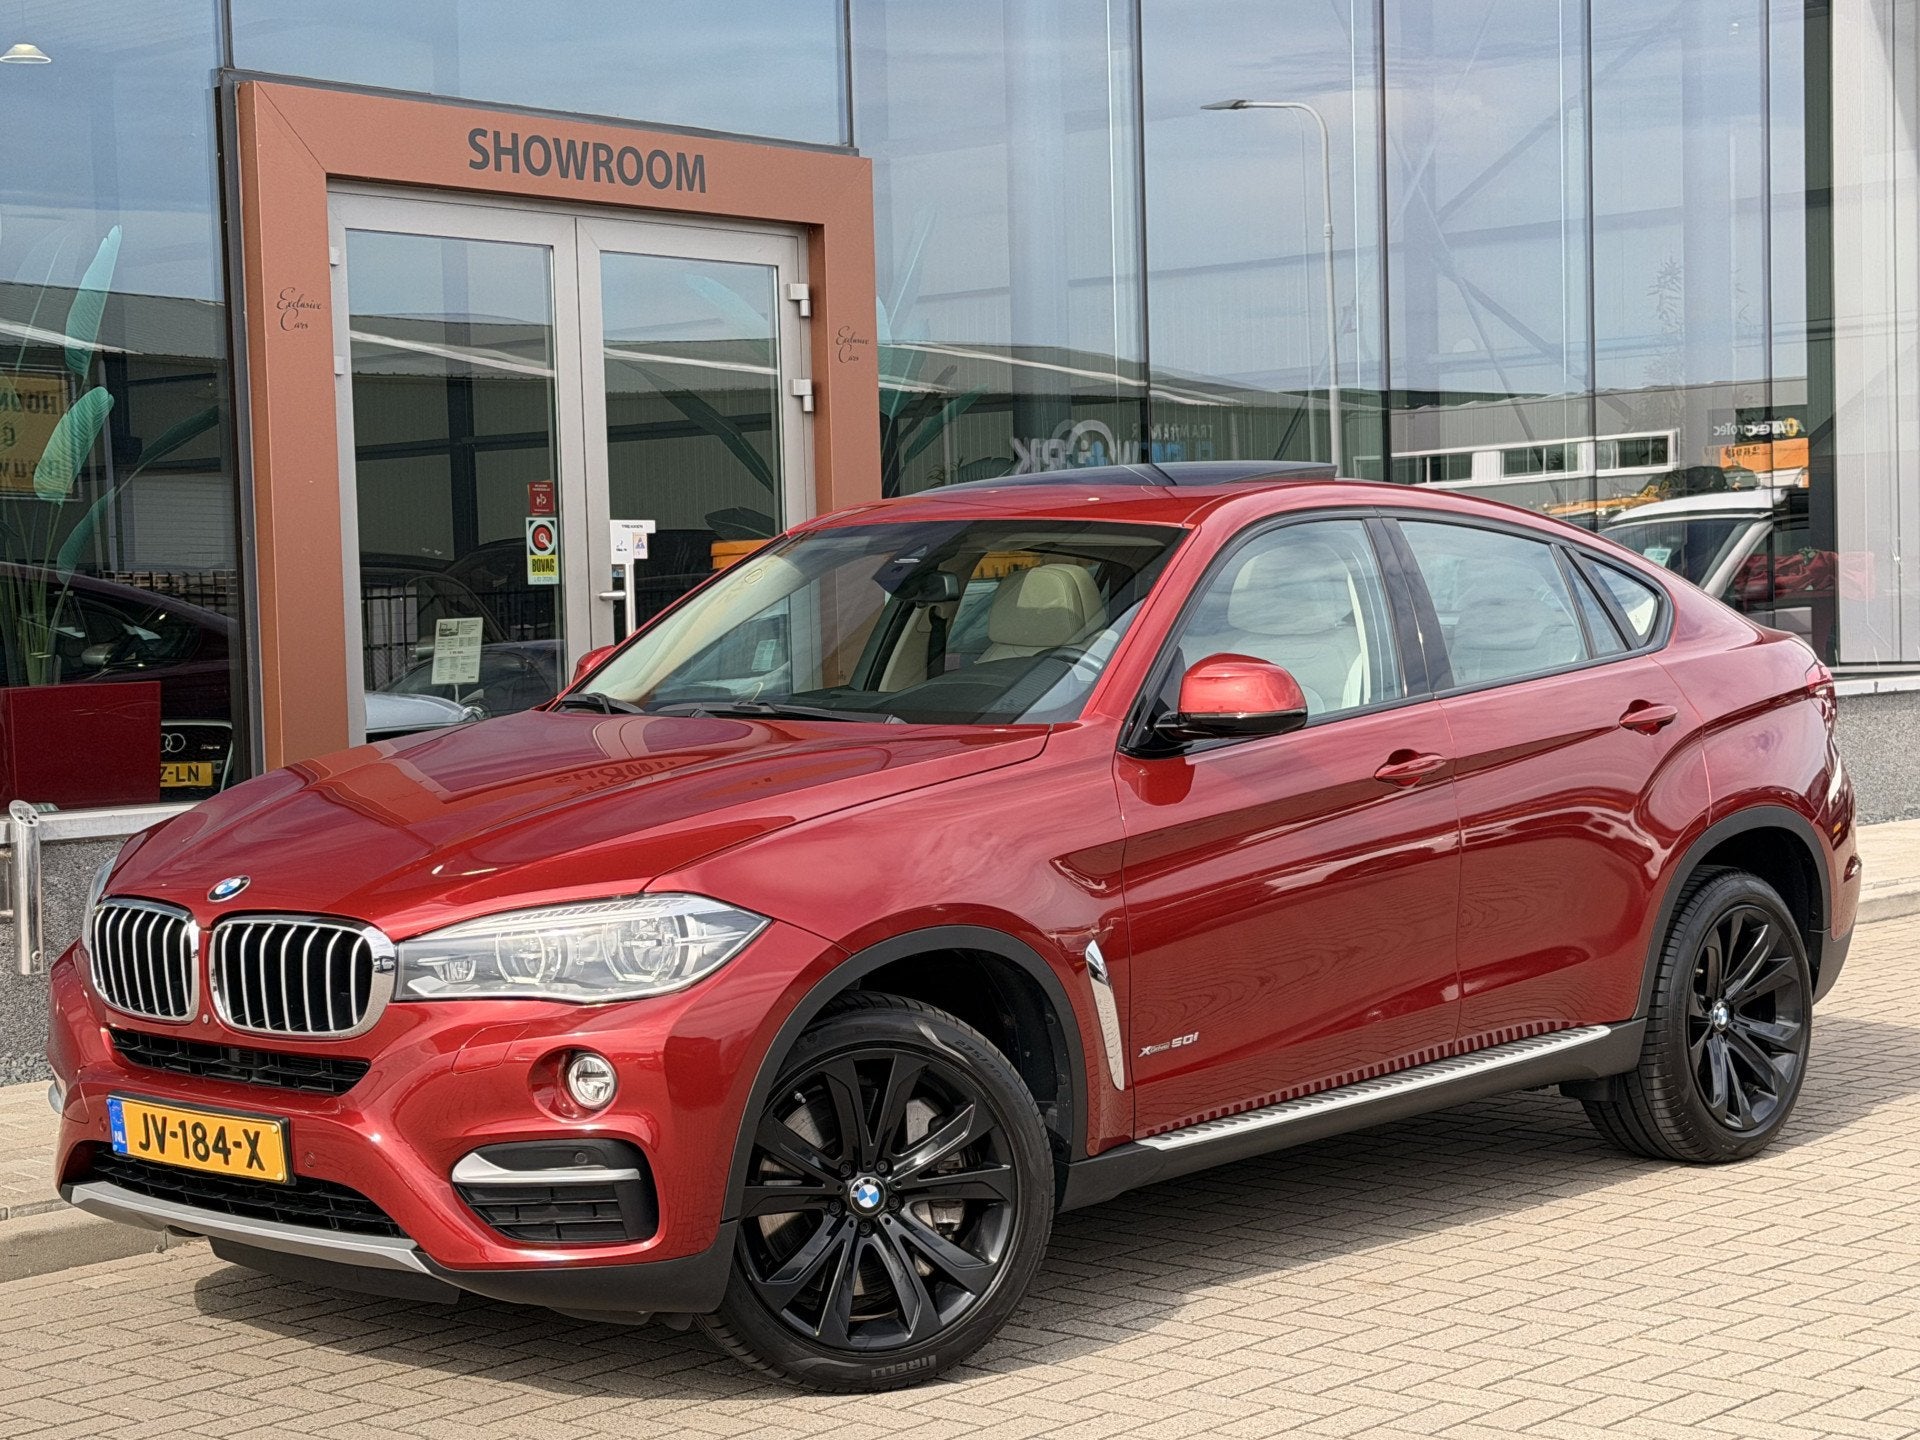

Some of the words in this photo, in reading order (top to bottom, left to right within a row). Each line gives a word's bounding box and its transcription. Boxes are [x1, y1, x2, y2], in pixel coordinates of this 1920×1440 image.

[468, 127, 707, 193] SHOWROOM
[532, 558, 555, 573] BOVAG
[114, 1131, 126, 1144] NL
[138, 1112, 266, 1171] JV-184-X
